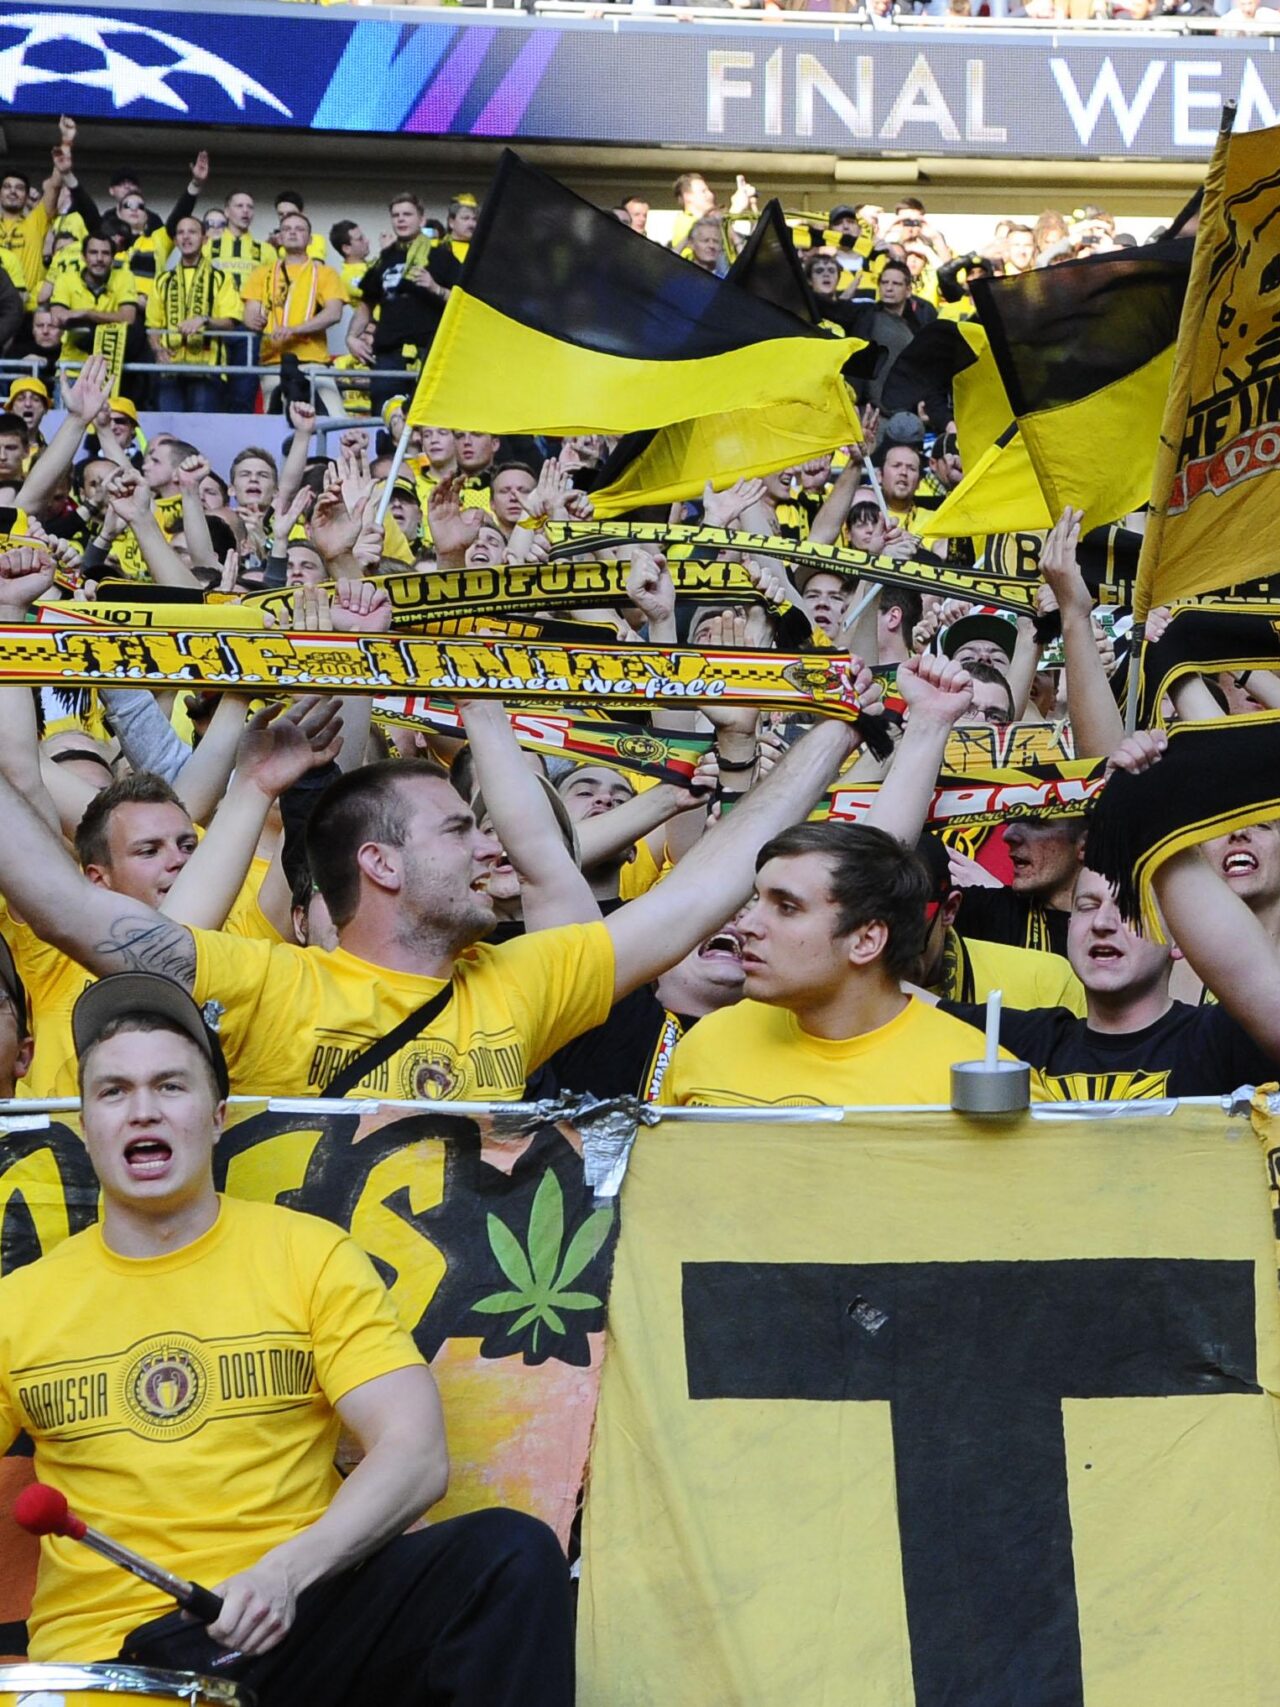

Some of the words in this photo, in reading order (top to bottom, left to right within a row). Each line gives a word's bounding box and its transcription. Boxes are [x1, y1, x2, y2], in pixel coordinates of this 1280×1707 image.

[706, 46, 1007, 144] FINAL
[391, 570, 495, 606] UND
[277, 671, 392, 687] stand
[430, 674, 570, 691] divided
[583, 678, 632, 696] we
[645, 678, 726, 698] fall
[310, 661, 363, 676] 2001
[19, 1371, 109, 1430] BORUSSIA
